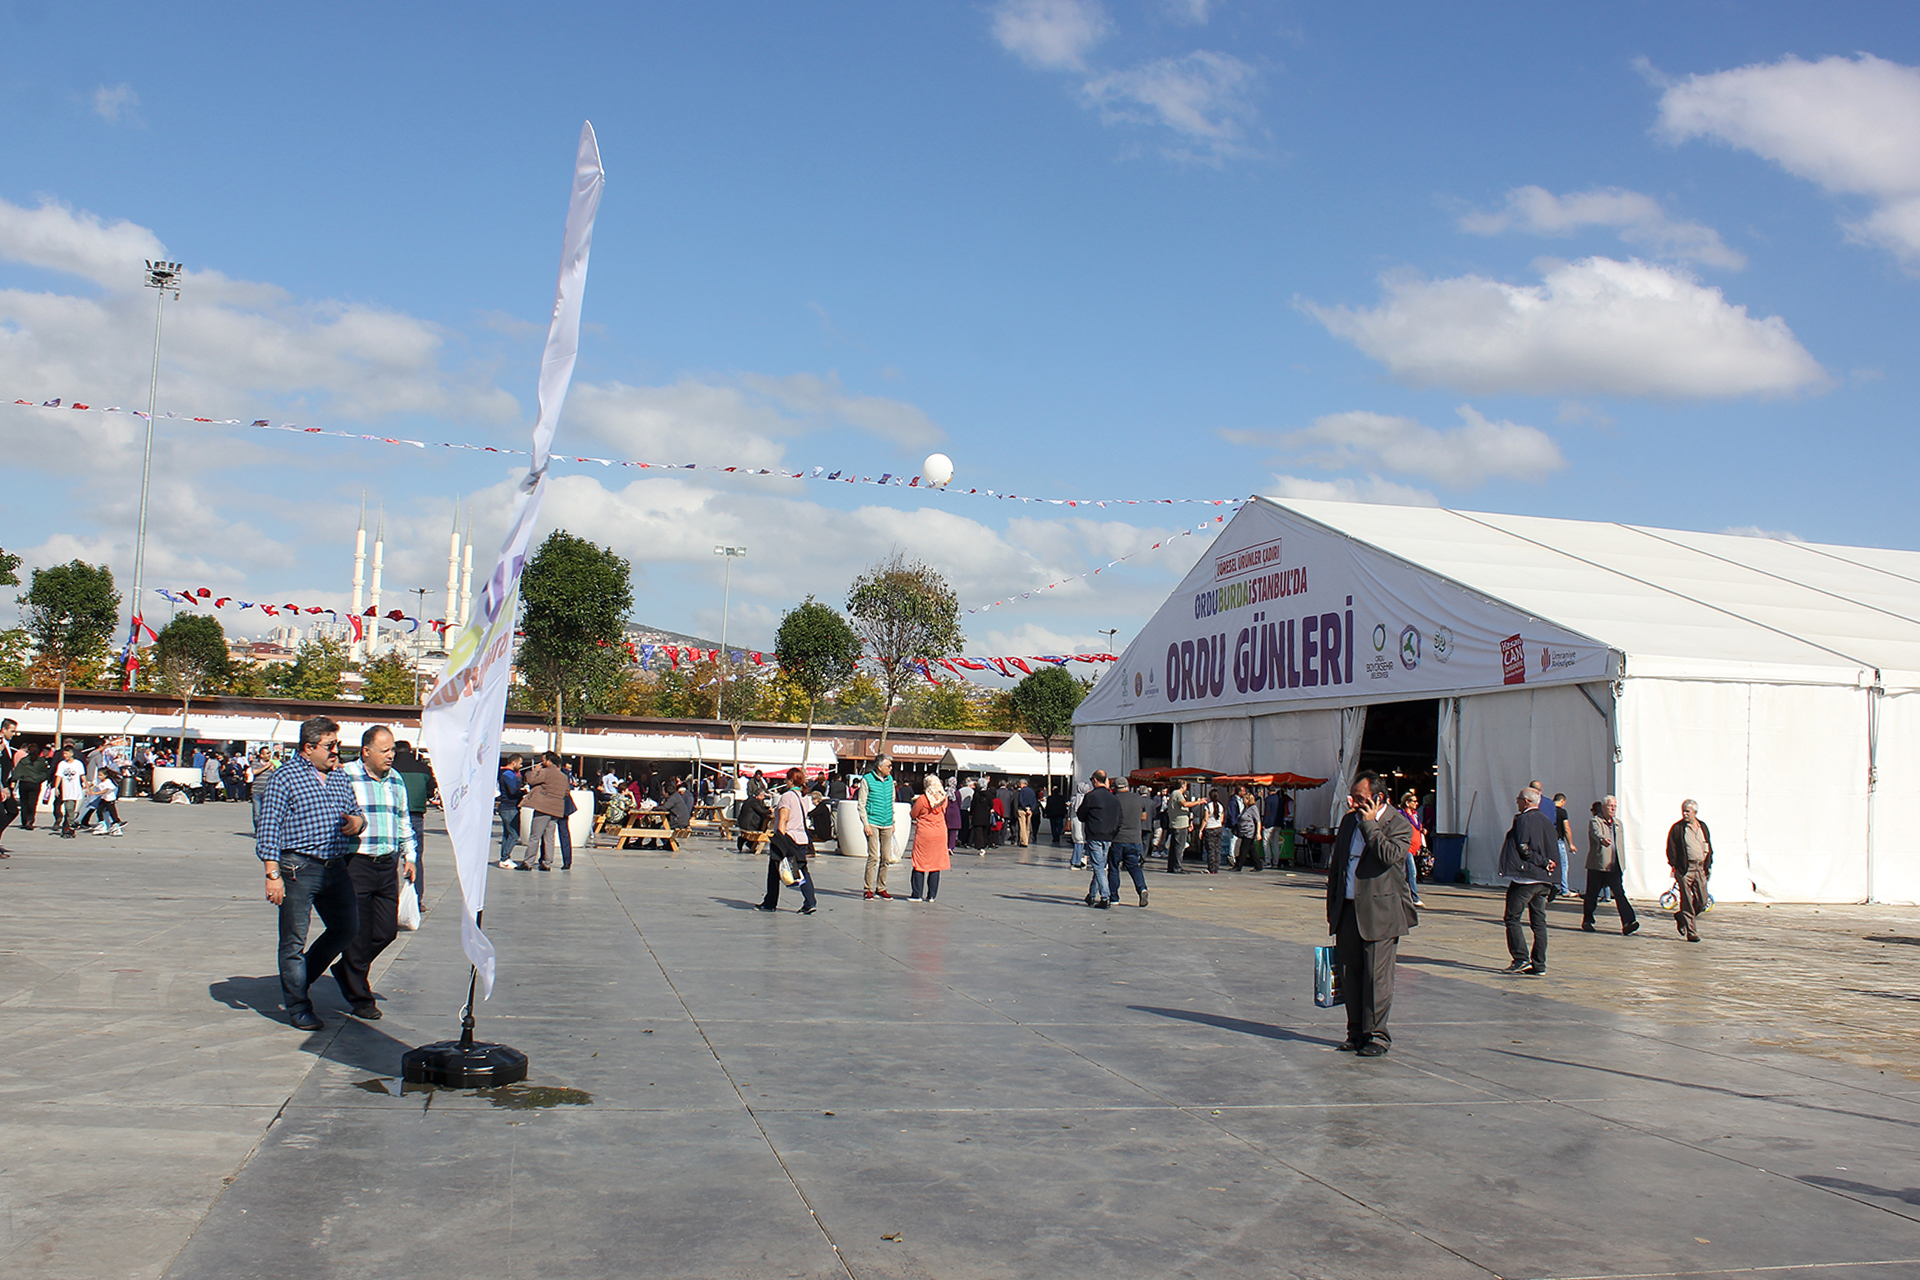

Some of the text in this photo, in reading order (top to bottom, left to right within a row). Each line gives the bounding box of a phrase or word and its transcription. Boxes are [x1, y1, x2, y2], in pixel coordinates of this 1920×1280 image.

[1238, 550, 1261, 570] ÜRÜNLER
[1166, 595, 1353, 702] ORDU GÜNLERİ
[1504, 645, 1523, 665] CAN
[892, 744, 916, 754] ORDU
